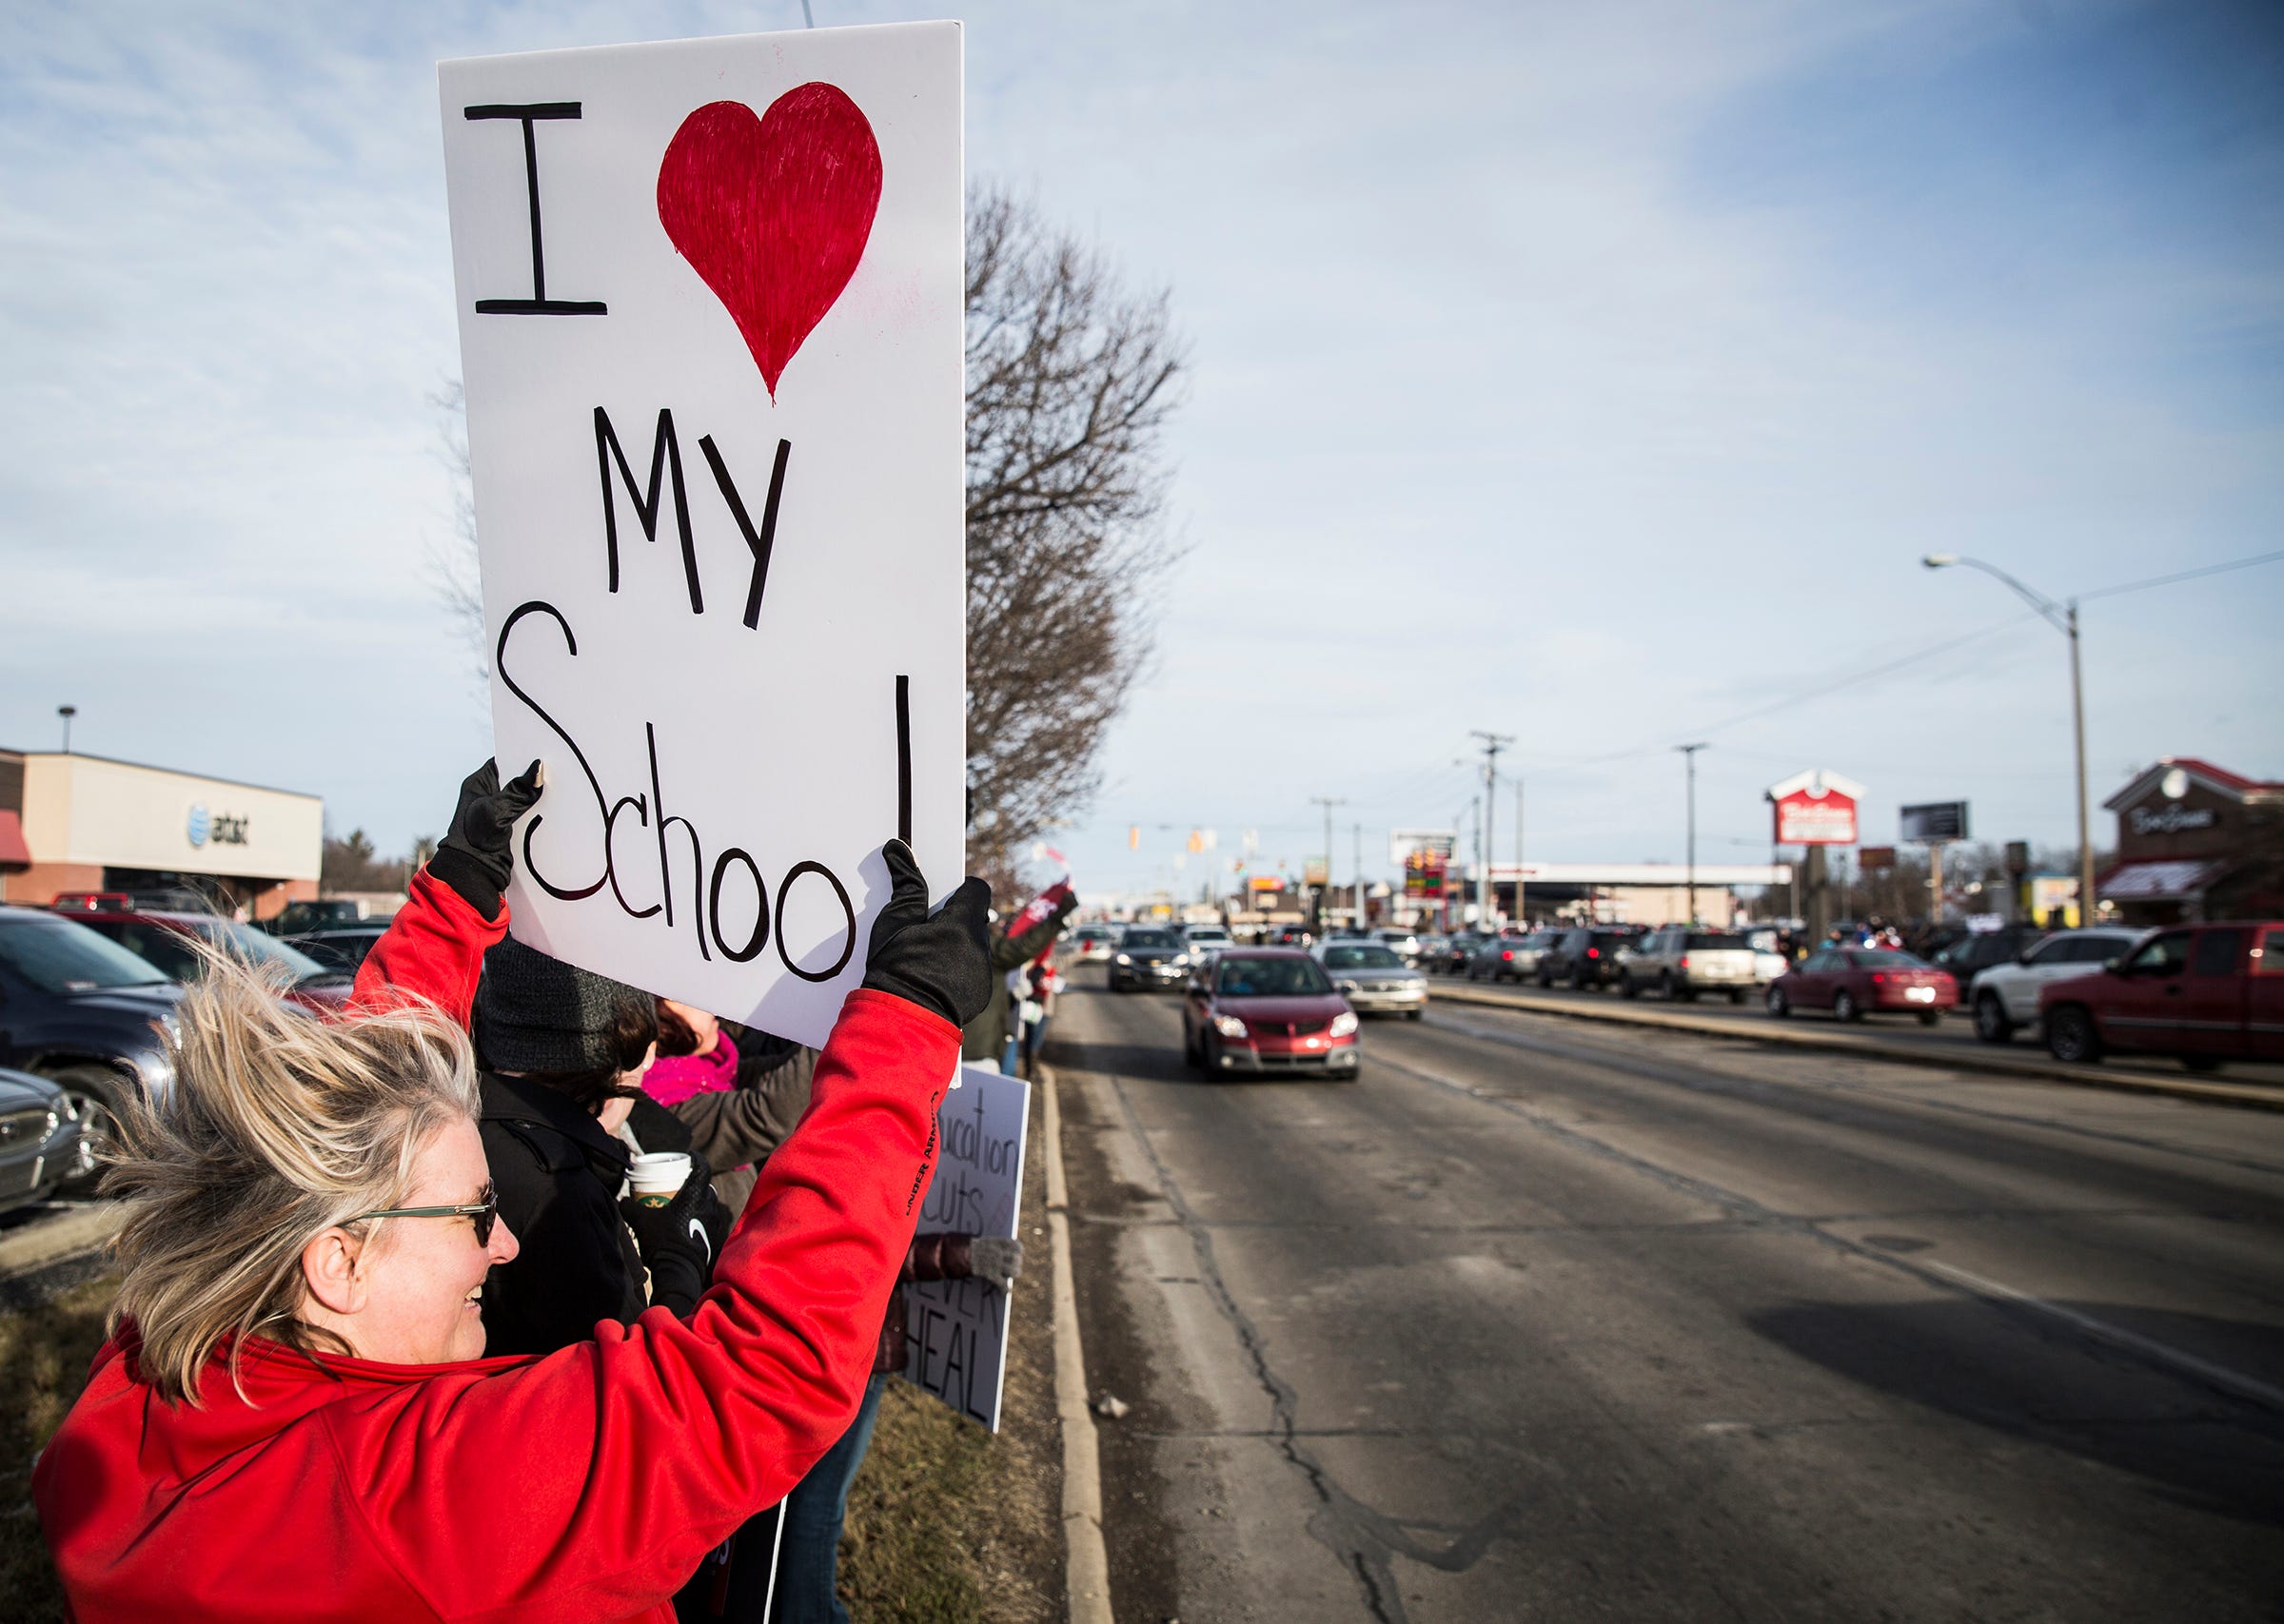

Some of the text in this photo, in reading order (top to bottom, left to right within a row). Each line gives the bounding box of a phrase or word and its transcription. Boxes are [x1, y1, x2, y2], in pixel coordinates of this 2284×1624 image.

[463, 101, 608, 316] I
[936, 1086, 1021, 1188] ucation
[904, 1298, 988, 1423] HEAL
